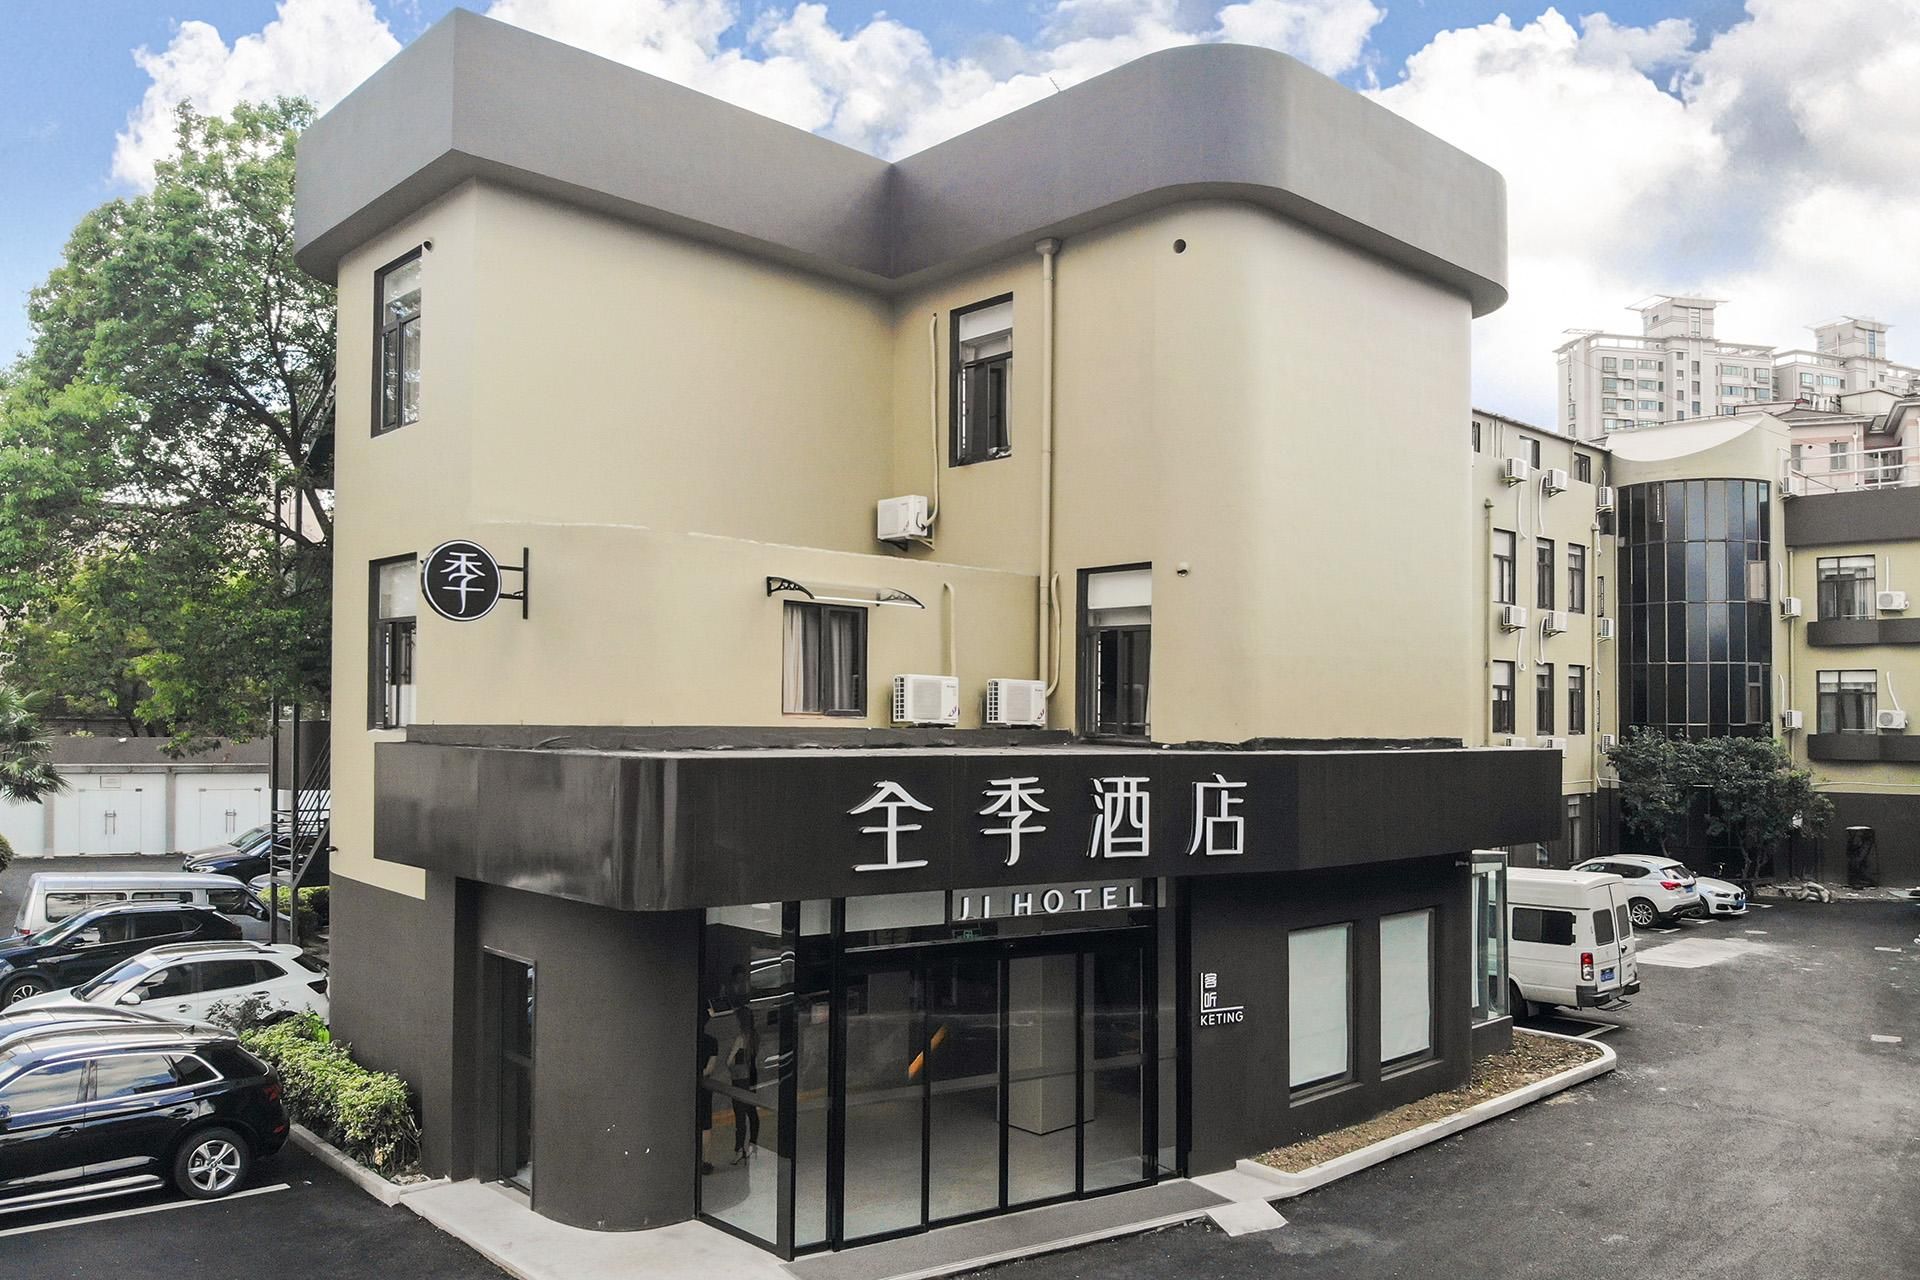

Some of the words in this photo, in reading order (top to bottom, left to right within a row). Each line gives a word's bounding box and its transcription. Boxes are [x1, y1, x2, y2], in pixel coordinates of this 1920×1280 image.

[440, 551, 486, 615] 季
[846, 772, 1248, 872] 全季酒店
[957, 895, 991, 921] JI
[1013, 886, 1144, 917] HOTEL
[1200, 1010, 1244, 1026] KETING
